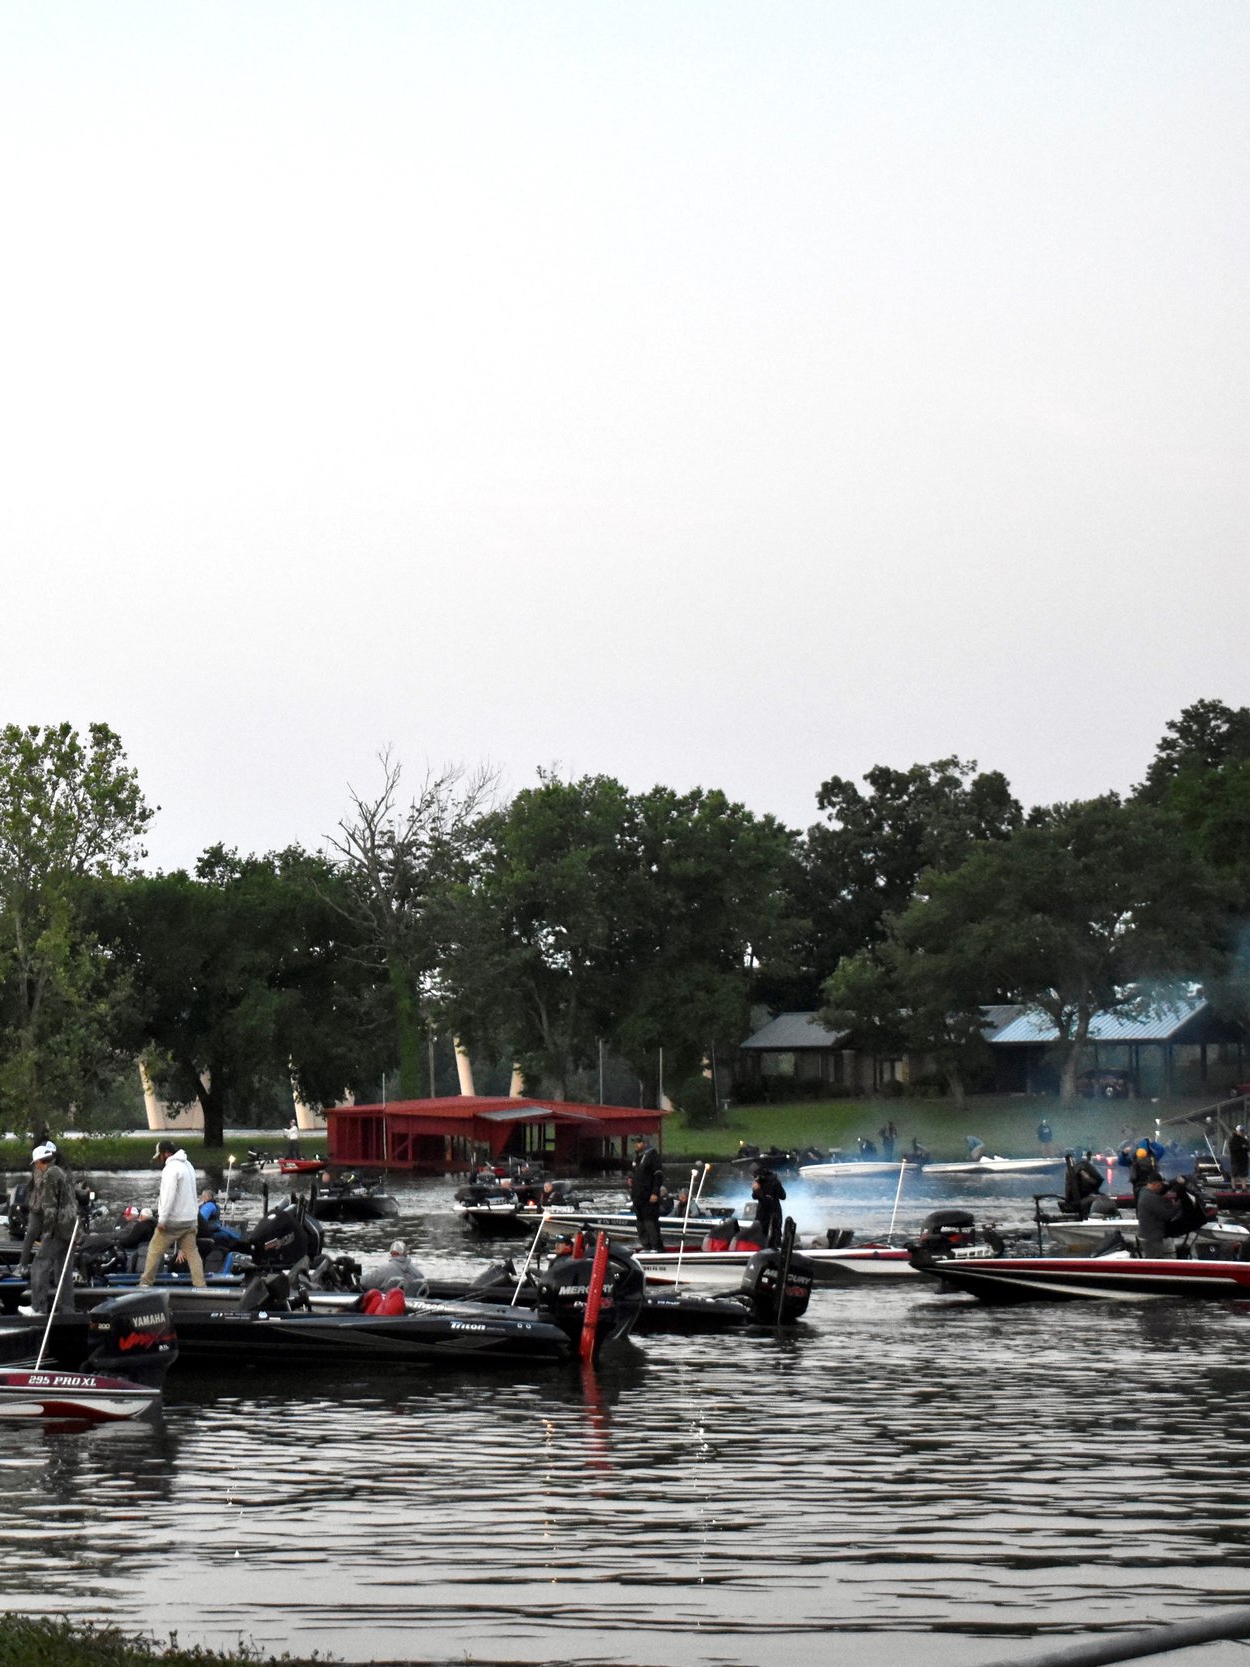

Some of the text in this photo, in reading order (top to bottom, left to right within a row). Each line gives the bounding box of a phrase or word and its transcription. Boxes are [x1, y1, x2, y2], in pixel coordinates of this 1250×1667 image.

[132, 1312, 166, 1328] YAMAHA
[28, 1375, 97, 1387] 295 PRO XL
